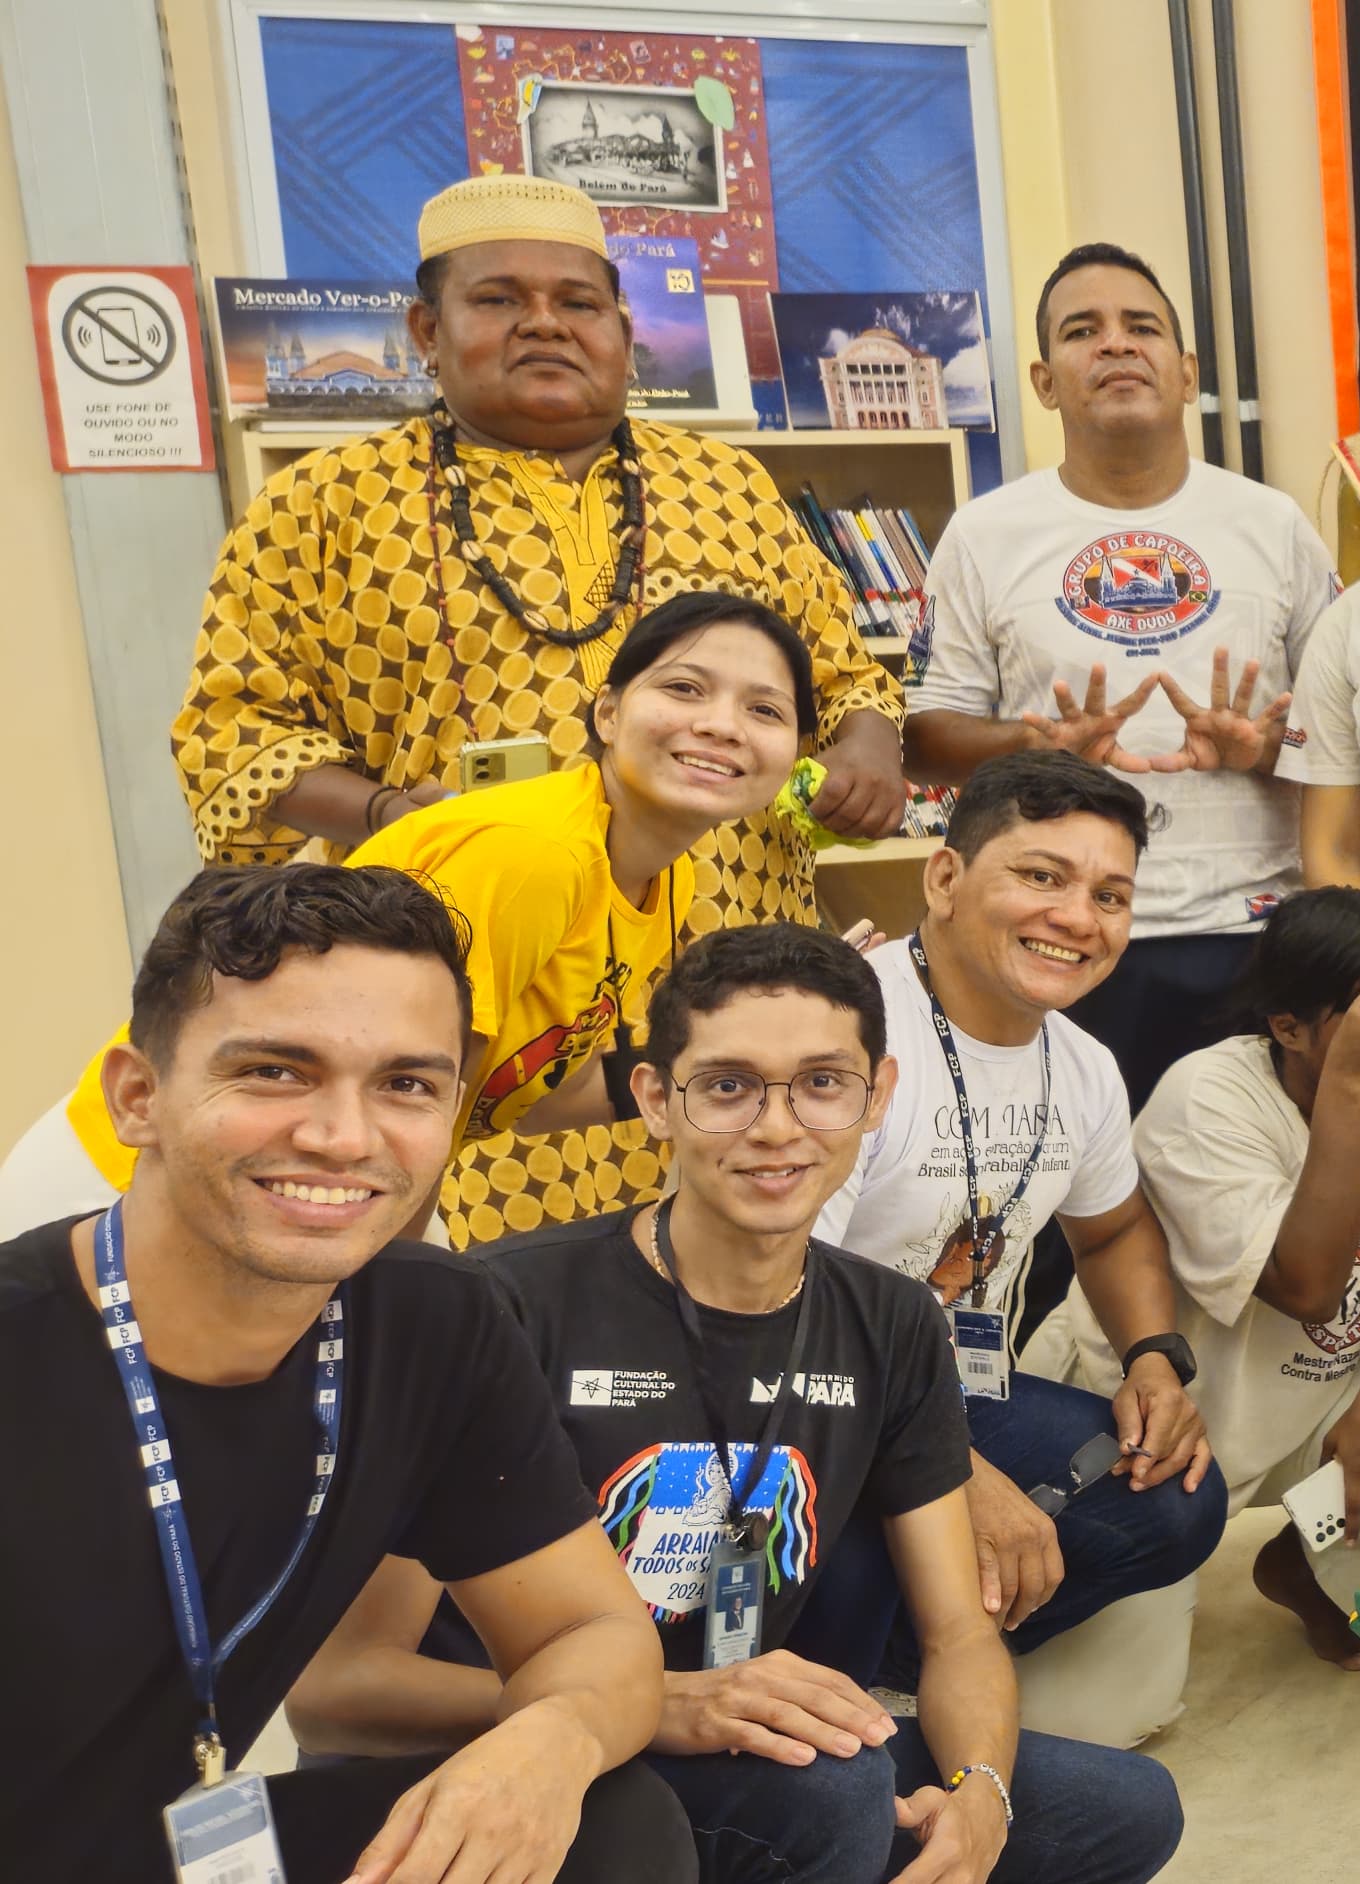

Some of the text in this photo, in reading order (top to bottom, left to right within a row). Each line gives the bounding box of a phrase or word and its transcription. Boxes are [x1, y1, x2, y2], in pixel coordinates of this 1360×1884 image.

[233, 287, 417, 308] Mercado Ver-o-Pe
[86, 402, 171, 413] USE FONE DE
[84, 417, 178, 428] OUVIDO OU NO
[113, 432, 153, 442] MODO
[88, 447, 166, 457] SILENCIOSO
[1068, 534, 1208, 596] GRUPO DE CAPOEIRA
[1136, 610, 1177, 631] DUDU
[933, 1013, 950, 1037] FCP
[947, 1053, 962, 1077] FCP
[958, 1093, 969, 1118] FCP
[930, 1147, 951, 1159] em
[952, 1147, 981, 1163] aço
[965, 1134, 975, 1159] FCP
[917, 1163, 956, 1178] Brasil
[968, 1176, 977, 1200] FCP
[1002, 1197, 1019, 1218] FCP
[981, 1230, 997, 1254] FCP
[111, 1286, 121, 1303] FCP
[114, 1307, 126, 1323] FCP
[120, 1327, 131, 1344] FCP
[125, 1347, 138, 1365] FCP
[1293, 1351, 1333, 1369] Mestr
[613, 1369, 668, 1381] FUNDAÇÃO
[1280, 1364, 1322, 1382] Contra
[613, 1380, 676, 1390] CULTURAL DO
[611, 1398, 637, 1408] PARÁ
[612, 1390, 666, 1399] ESTADO DO
[147, 1424, 157, 1441] FCP
[151, 1445, 161, 1462] FCP
[156, 1465, 167, 1482] FCP
[161, 1486, 171, 1502] FCP
[651, 1530, 726, 1556] ARRAIA
[632, 1555, 685, 1574] TODOS
[667, 1582, 706, 1600] 2024
